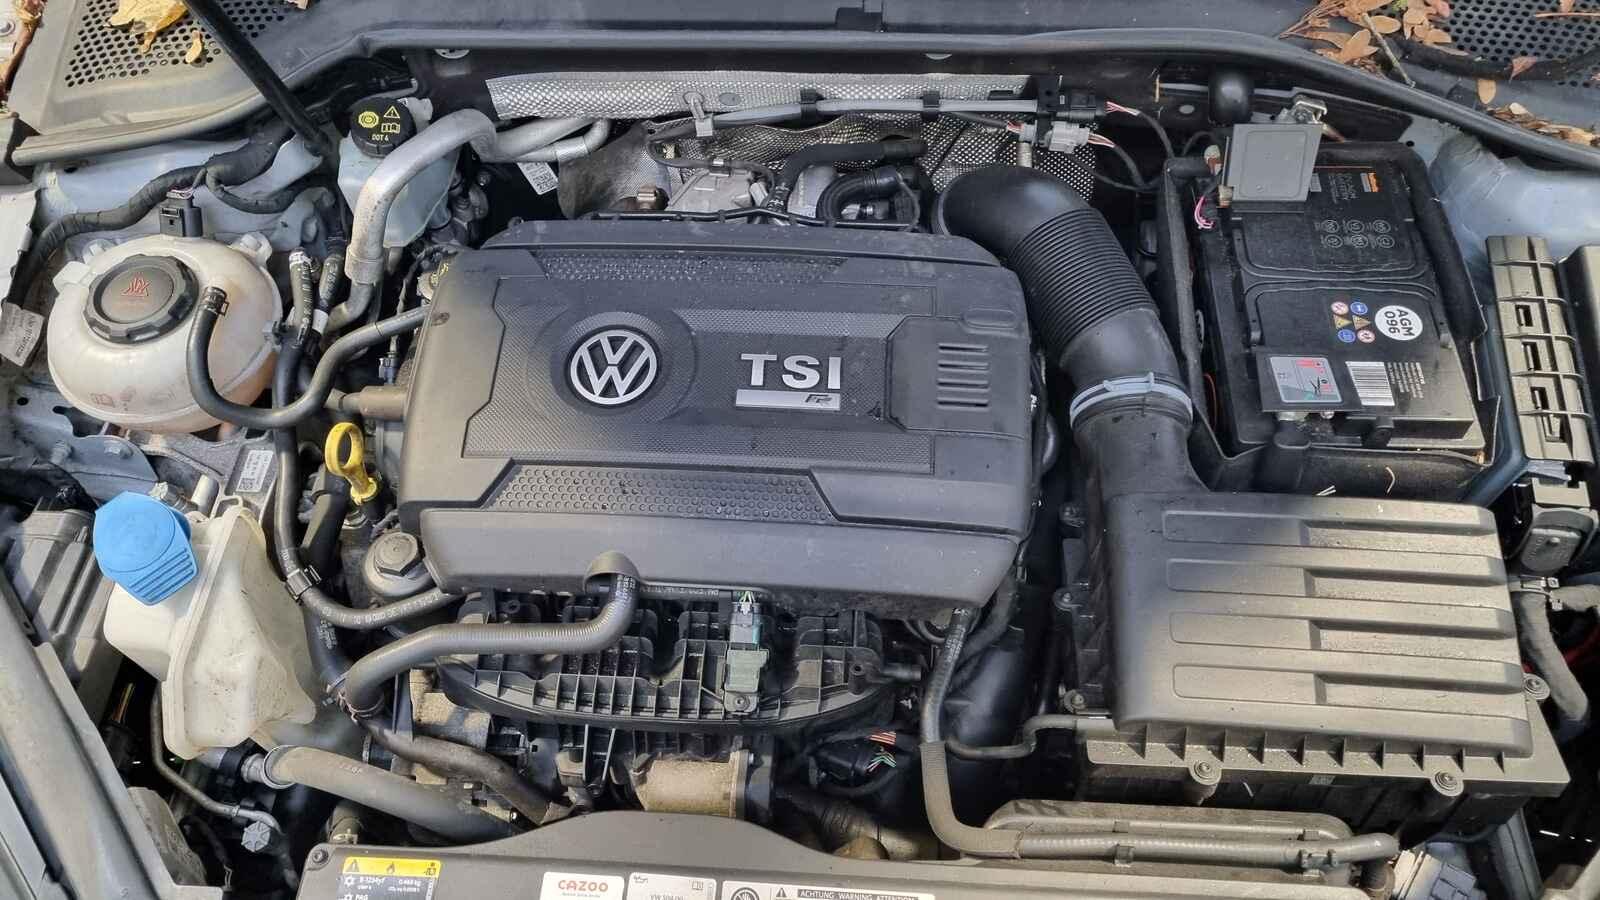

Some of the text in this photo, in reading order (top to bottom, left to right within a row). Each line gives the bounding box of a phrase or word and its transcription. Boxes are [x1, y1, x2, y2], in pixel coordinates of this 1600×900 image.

[371, 133, 384, 142] DOT
[1384, 310, 1400, 334] 096
[1396, 308, 1415, 337] AGM
[741, 353, 842, 389] TSI
[558, 879, 609, 892] CAZOO
[800, 889, 834, 899] ACHTUNG
